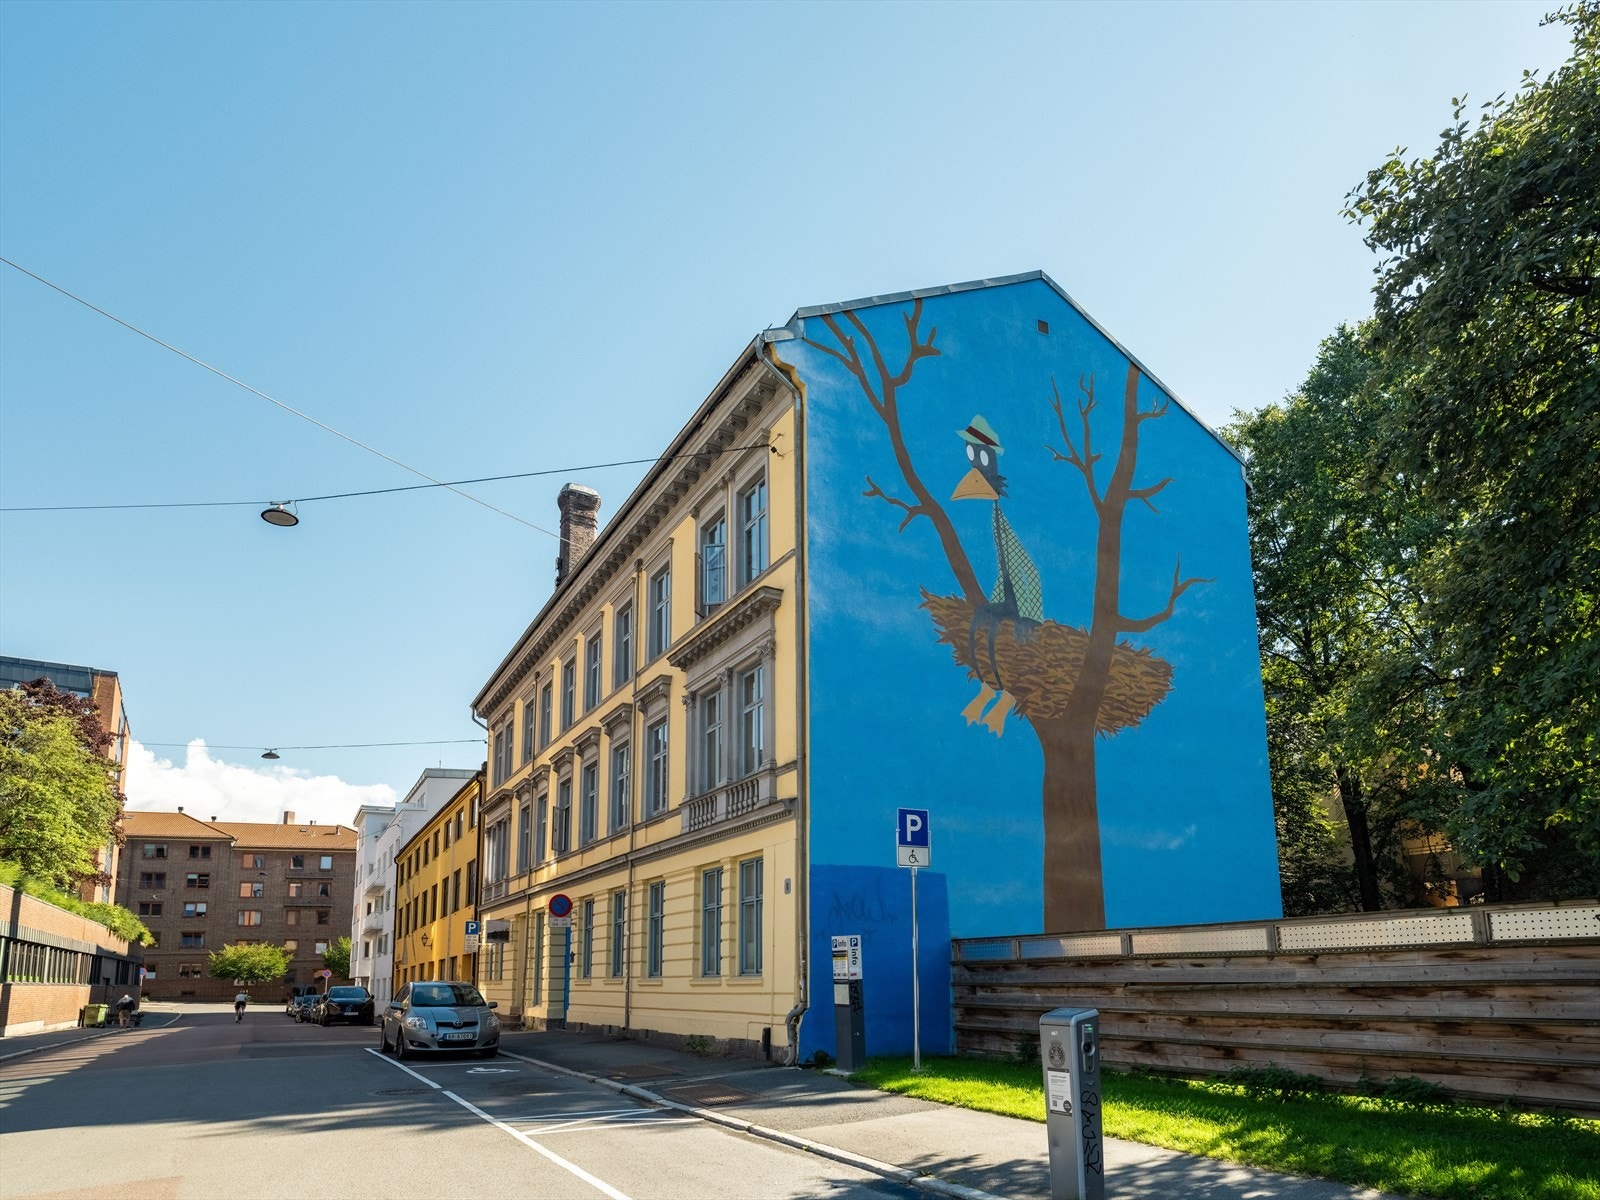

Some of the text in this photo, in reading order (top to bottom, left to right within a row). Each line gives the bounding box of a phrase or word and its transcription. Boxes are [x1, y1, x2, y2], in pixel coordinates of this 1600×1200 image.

[906, 814, 922, 842] P
[468, 922, 476, 934] P
[837, 939, 847, 948] info
